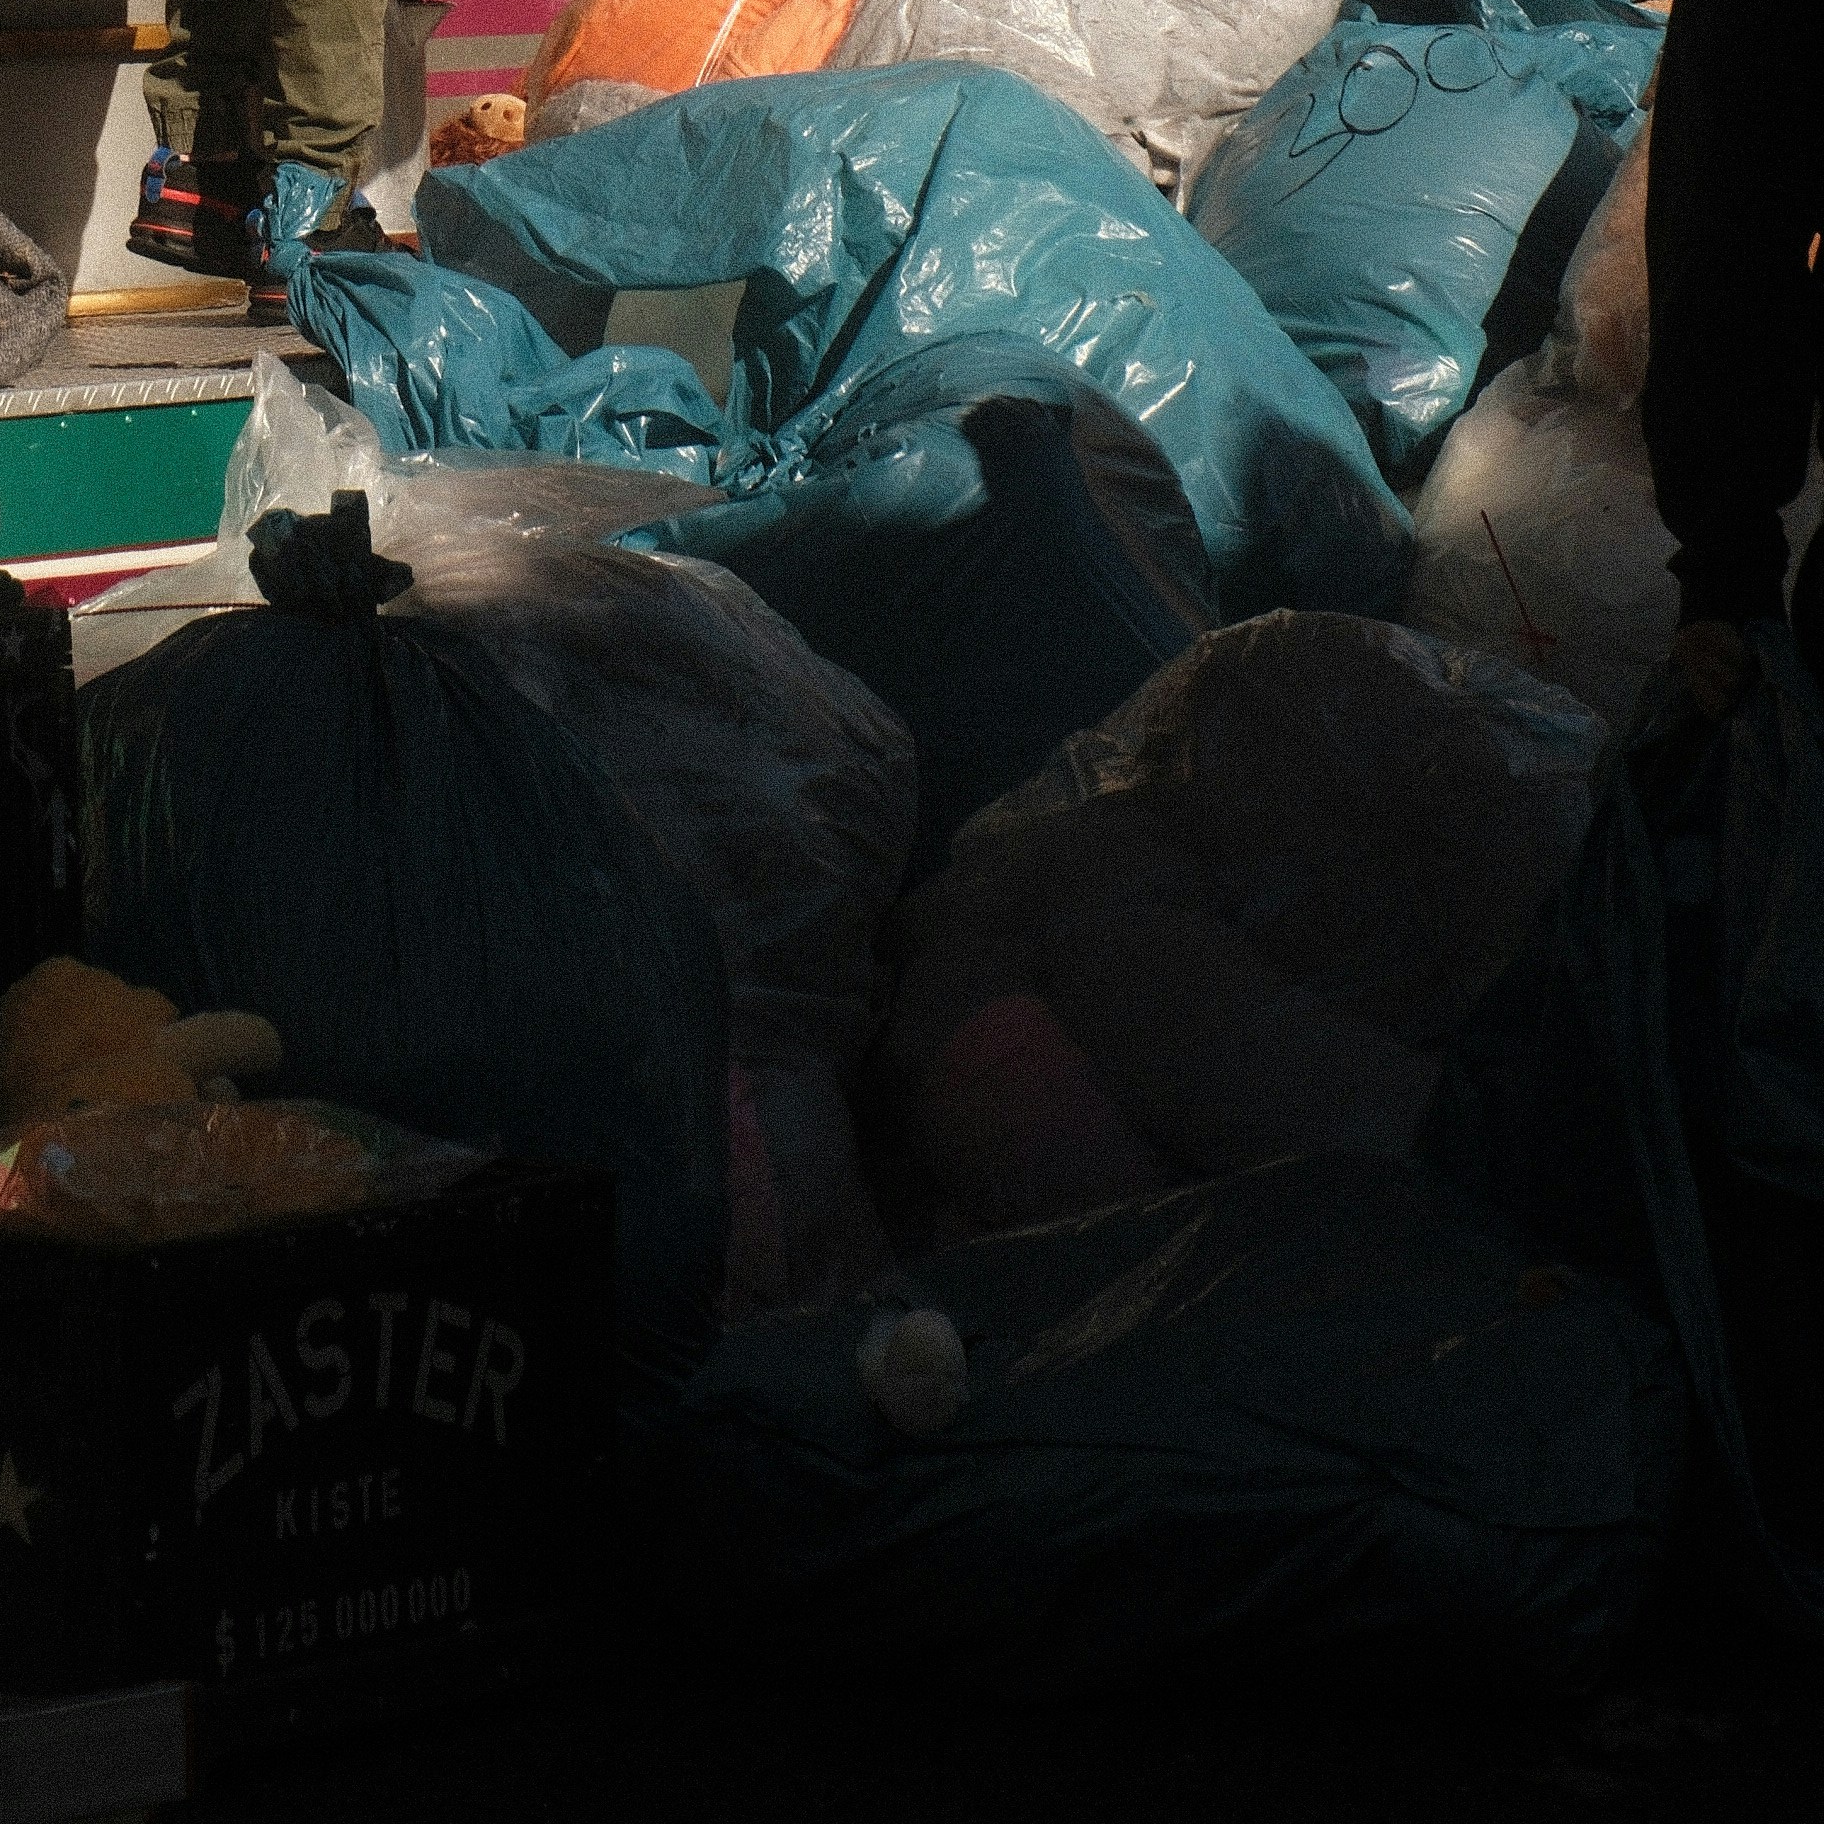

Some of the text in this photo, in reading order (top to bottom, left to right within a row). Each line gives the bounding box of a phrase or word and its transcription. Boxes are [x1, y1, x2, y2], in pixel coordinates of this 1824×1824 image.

[172, 1291, 526, 1528] ZASTER
[275, 1466, 402, 1541] KISTE
[254, 1598, 320, 1658] 125
